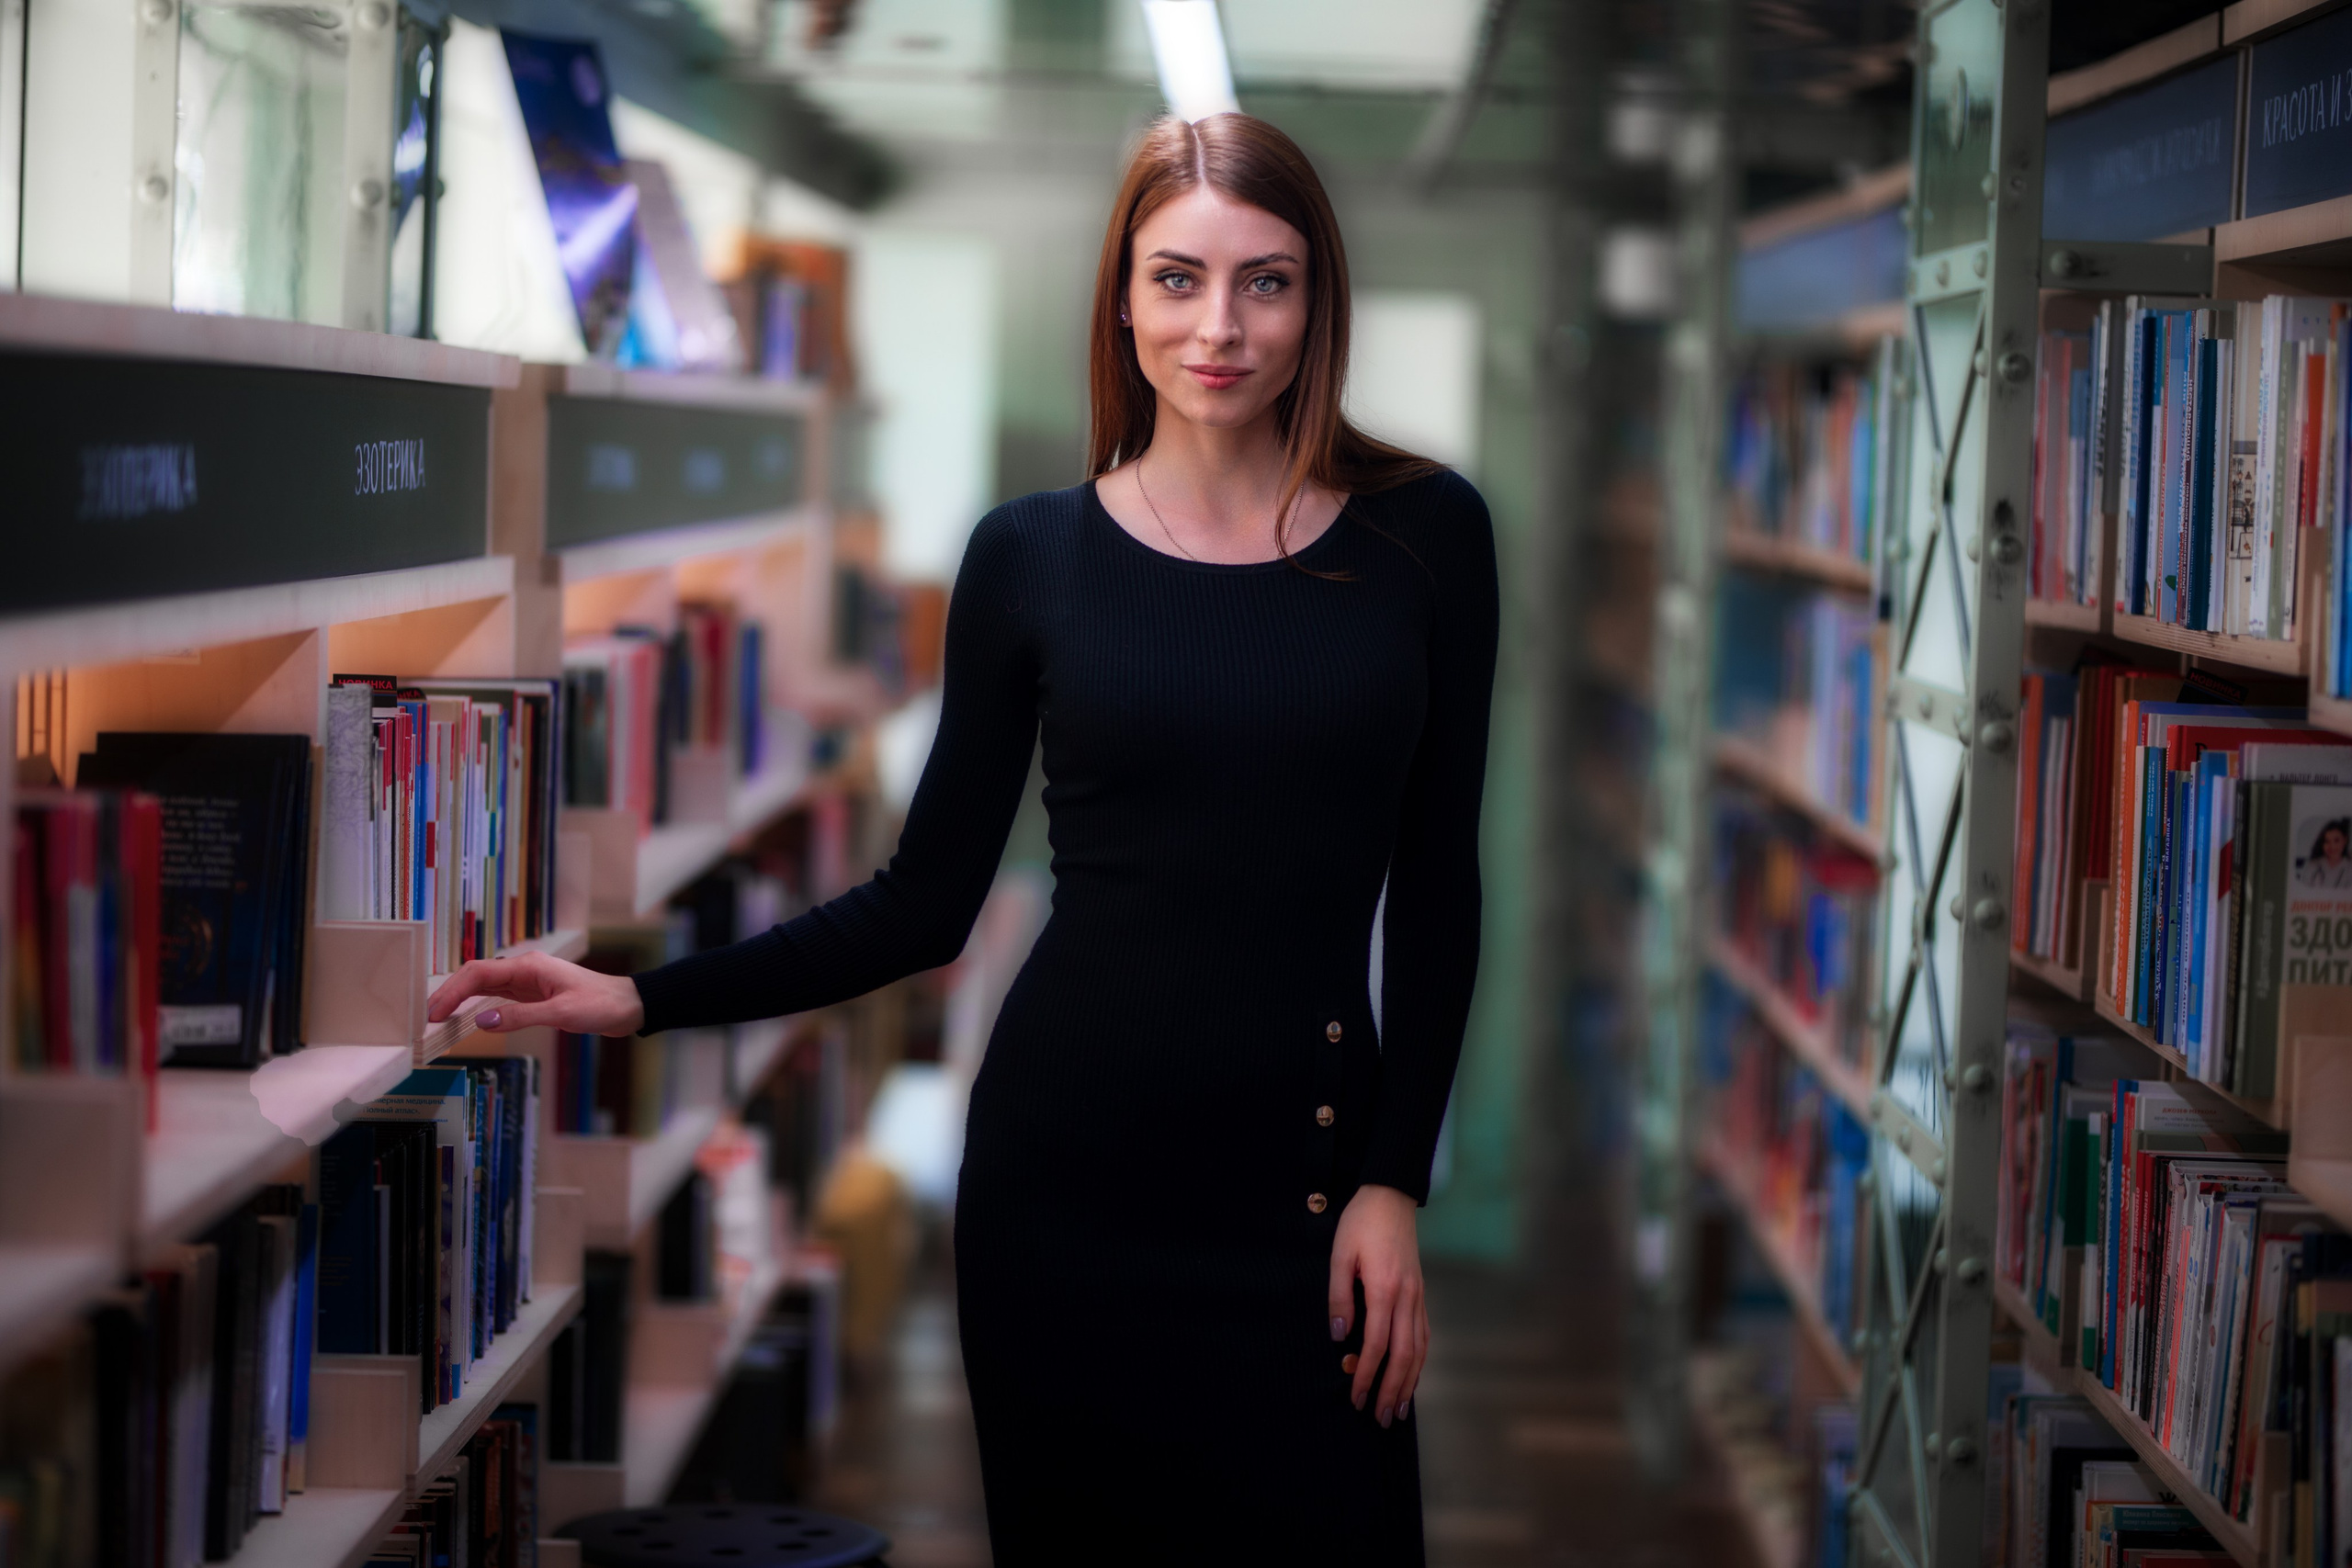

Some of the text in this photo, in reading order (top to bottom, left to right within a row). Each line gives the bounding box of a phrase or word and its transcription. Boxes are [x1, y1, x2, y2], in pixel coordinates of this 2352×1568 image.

[2262, 79, 2325, 148] КРАСОТА
[2329, 74, 2342, 127] И
[355, 438, 426, 496] ЭЗОТЕРИКА
[2190, 672, 2241, 699] НОВИНКА
[2314, 773, 2338, 784] ЛОНГО
